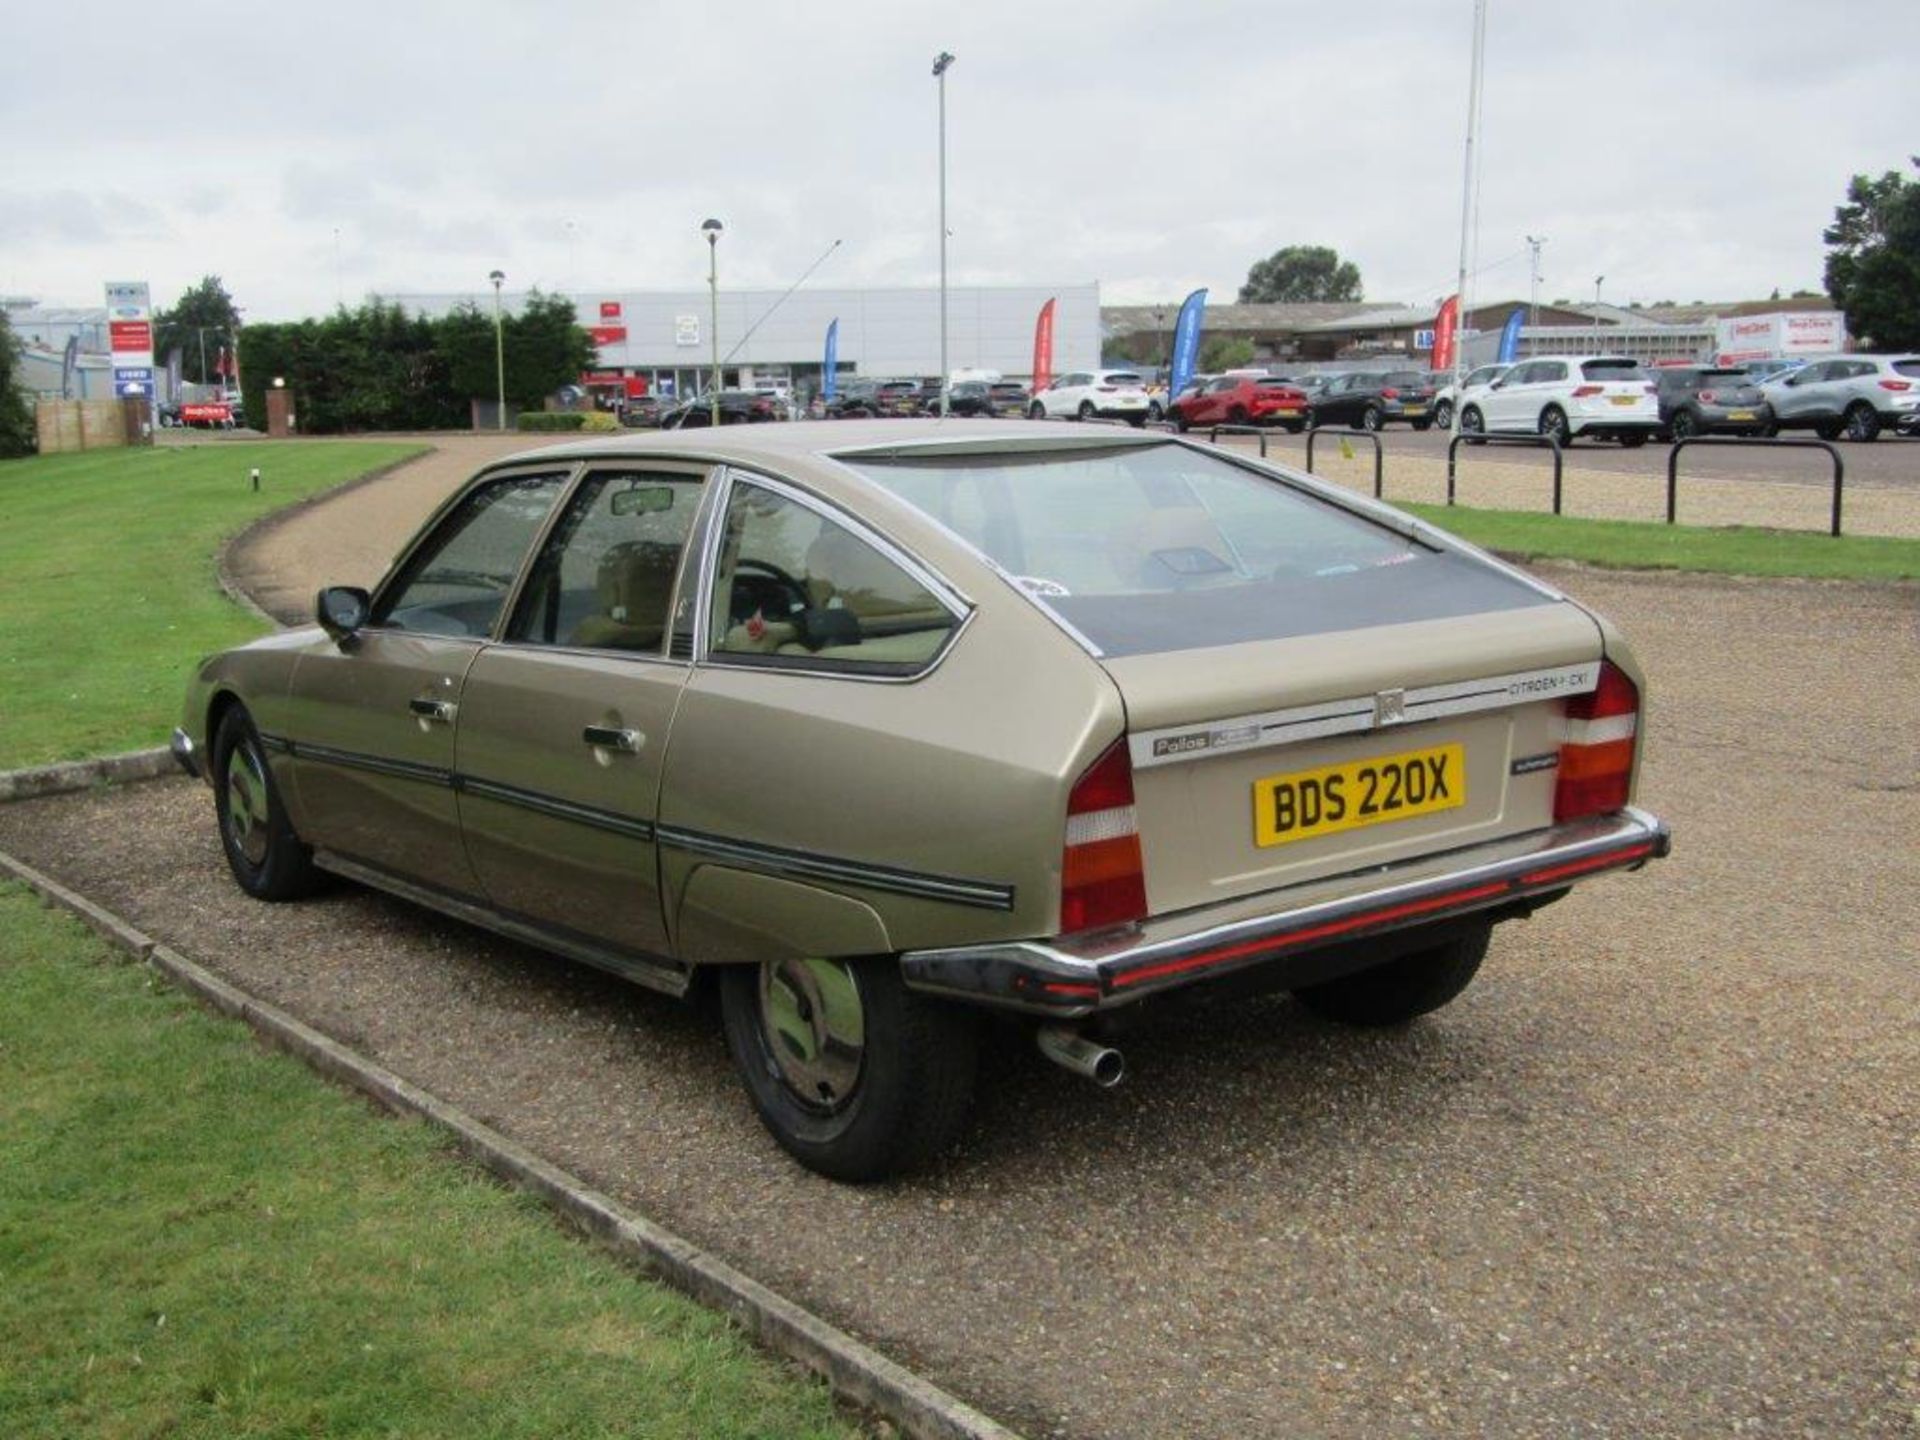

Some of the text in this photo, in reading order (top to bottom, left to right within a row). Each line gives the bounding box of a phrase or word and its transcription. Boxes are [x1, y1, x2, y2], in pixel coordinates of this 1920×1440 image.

[1156, 737, 1207, 754] Pallas
[1273, 753, 1449, 833] BDS 220X
